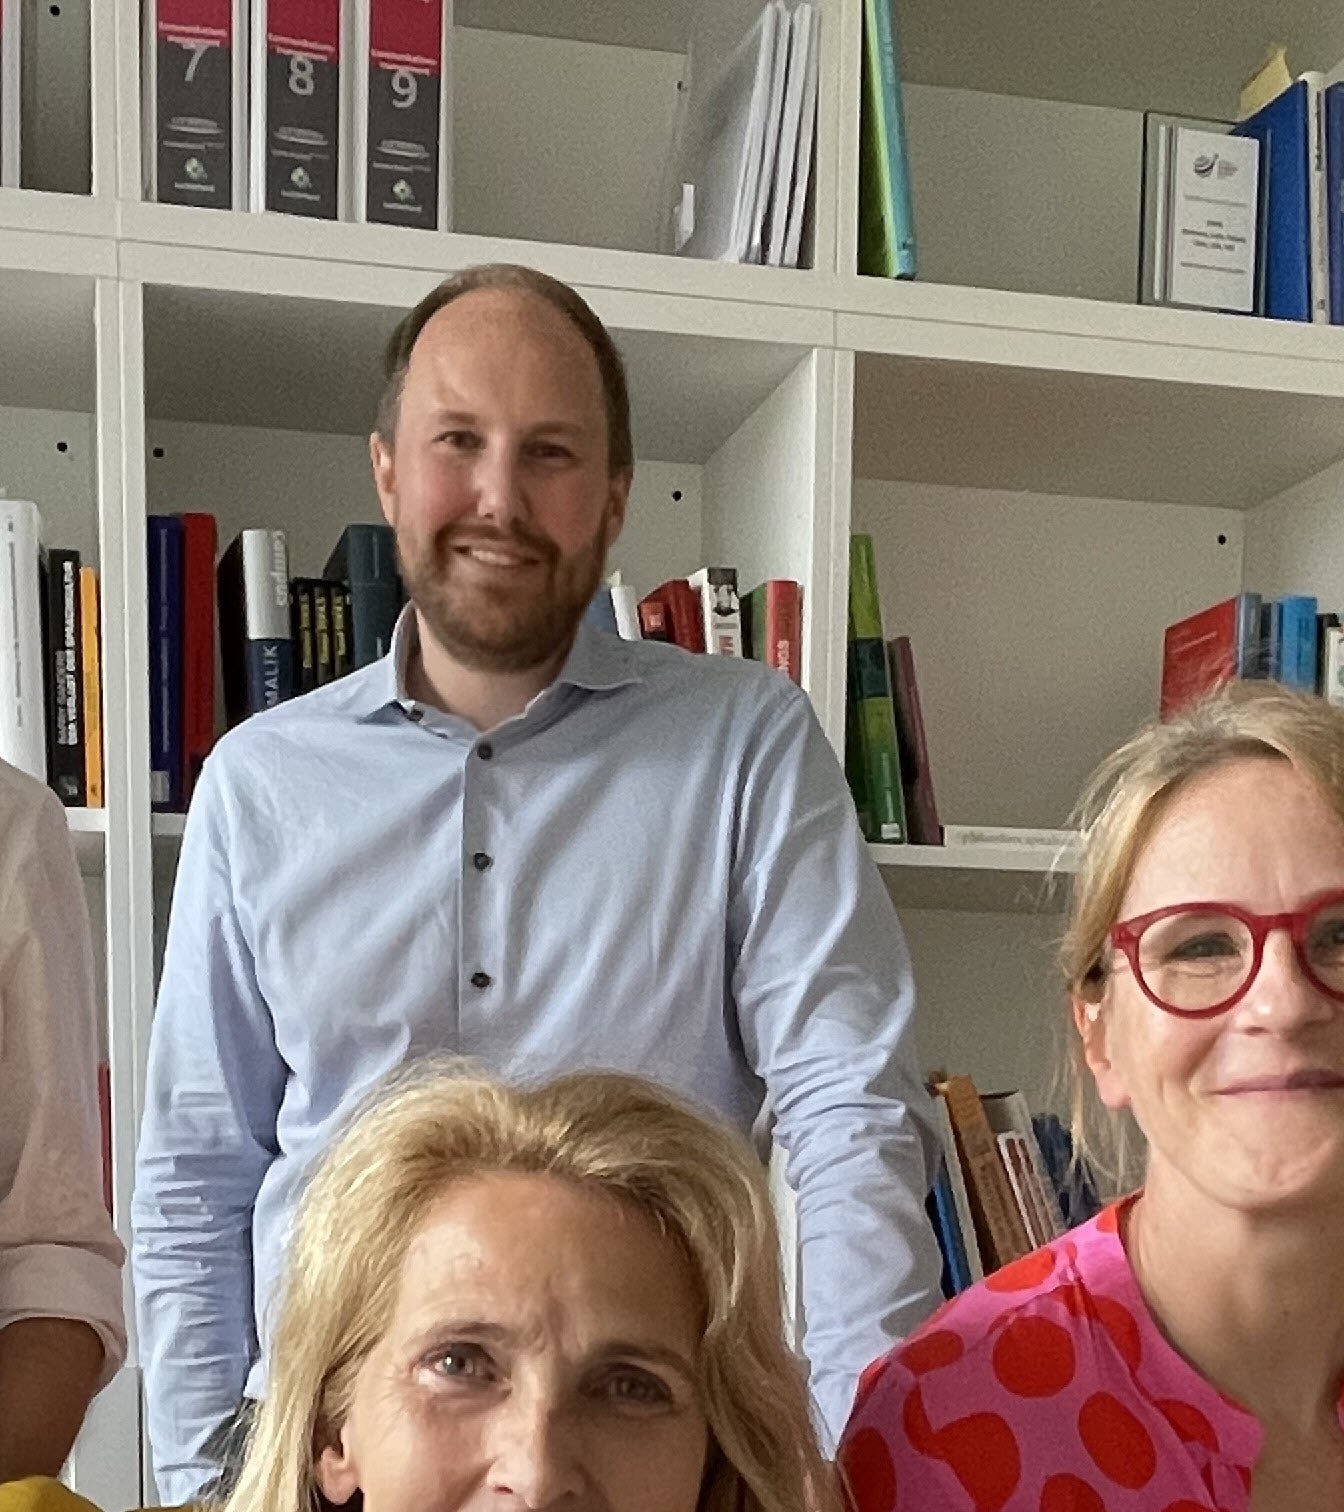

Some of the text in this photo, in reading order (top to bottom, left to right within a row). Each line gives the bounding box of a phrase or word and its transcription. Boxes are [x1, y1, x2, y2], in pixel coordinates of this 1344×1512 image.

[182, 43, 208, 82] 7
[288, 56, 315, 96] 8
[390, 70, 418, 109] 9
[261, 644, 280, 705] MALIK
